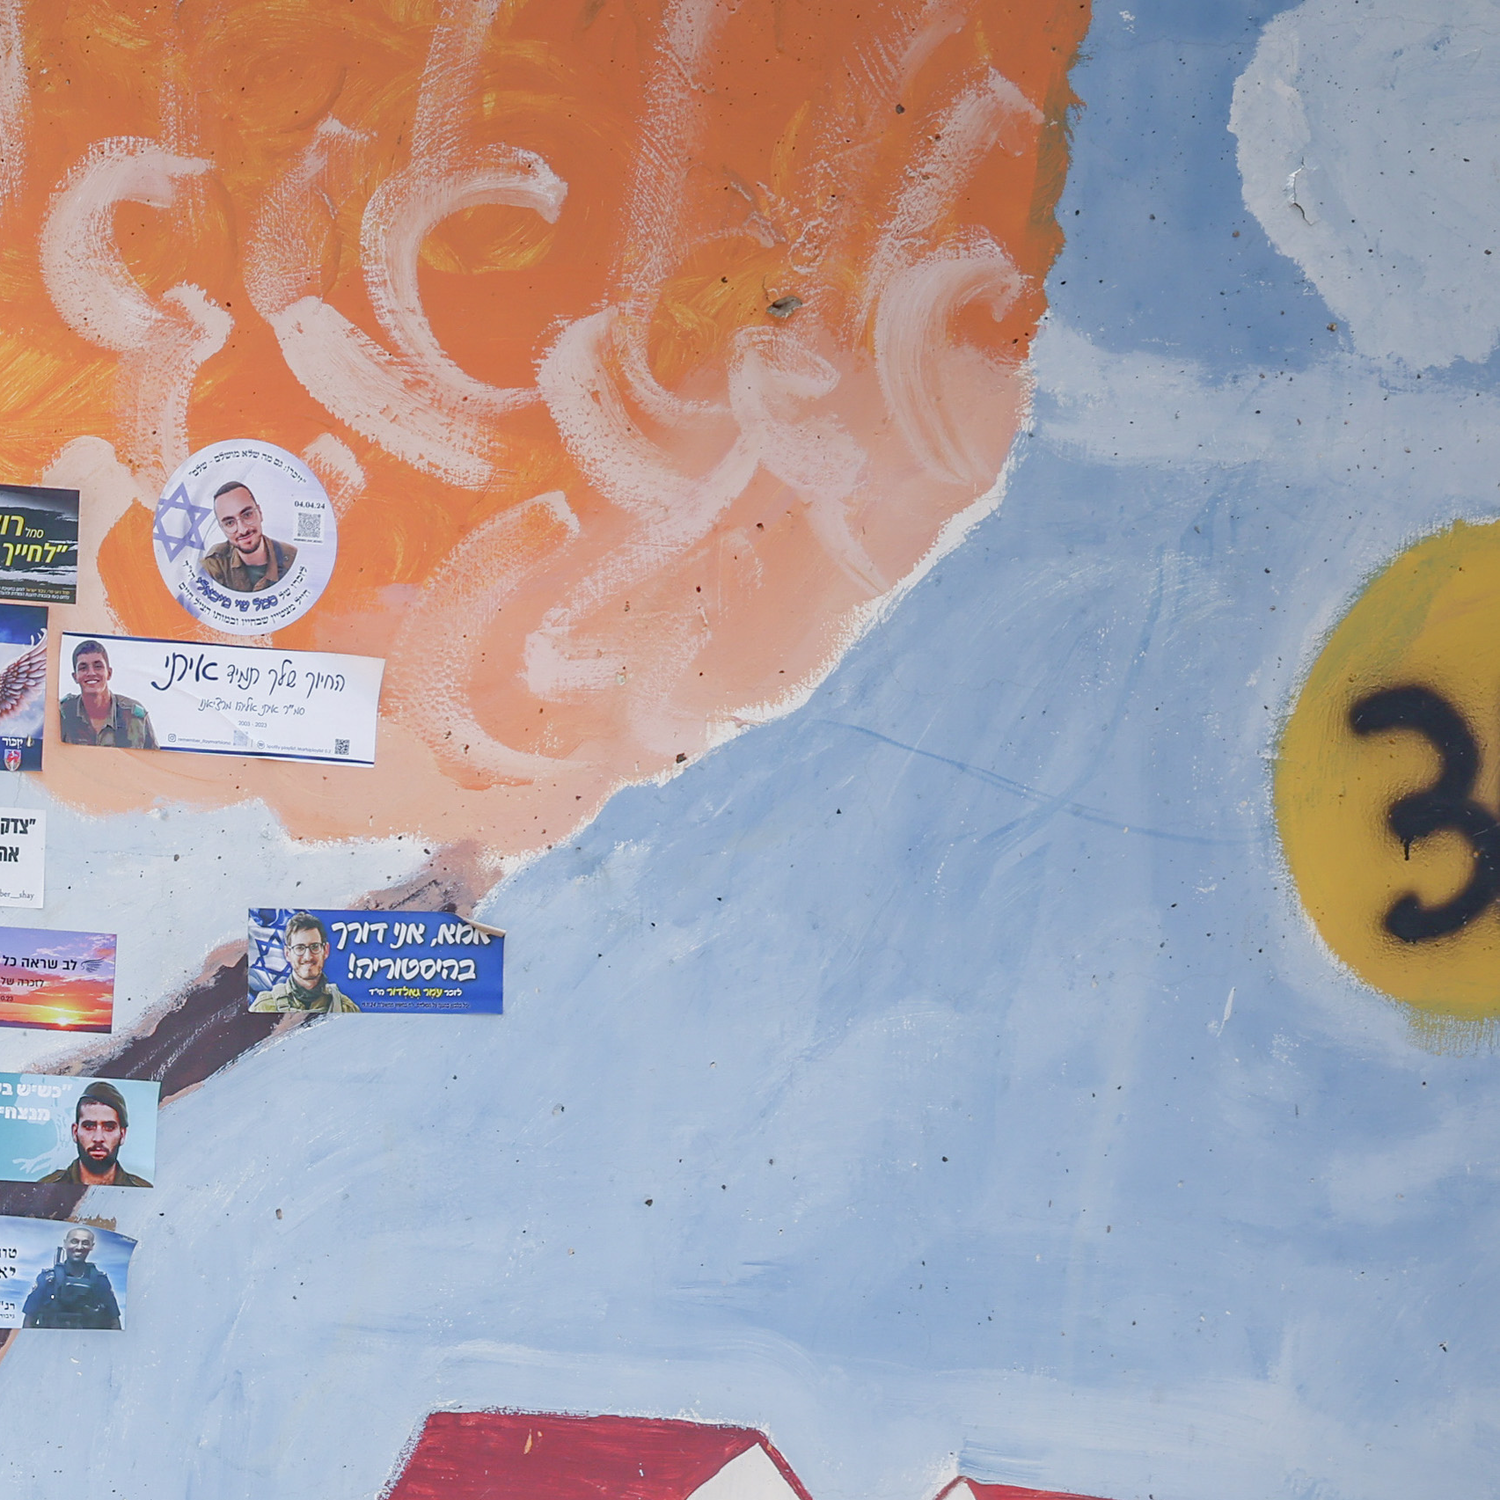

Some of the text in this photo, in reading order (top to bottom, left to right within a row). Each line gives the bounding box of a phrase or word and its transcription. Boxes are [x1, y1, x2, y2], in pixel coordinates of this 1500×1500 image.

[25, 528, 44, 538] סמל
[2, 542, 68, 566] "לחייך
[151, 651, 345, 698] החיוך שלך תמיד איתי
[0, 817, 36, 835] "צדק
[1349, 685, 1500, 943] 3
[331, 922, 388, 950] דורך
[389, 922, 426, 949] אני
[2, 953, 17, 968] כל
[21, 956, 58, 969] שראה
[62, 959, 77, 972] לב
[347, 953, 476, 982] בהיסטוריה!
